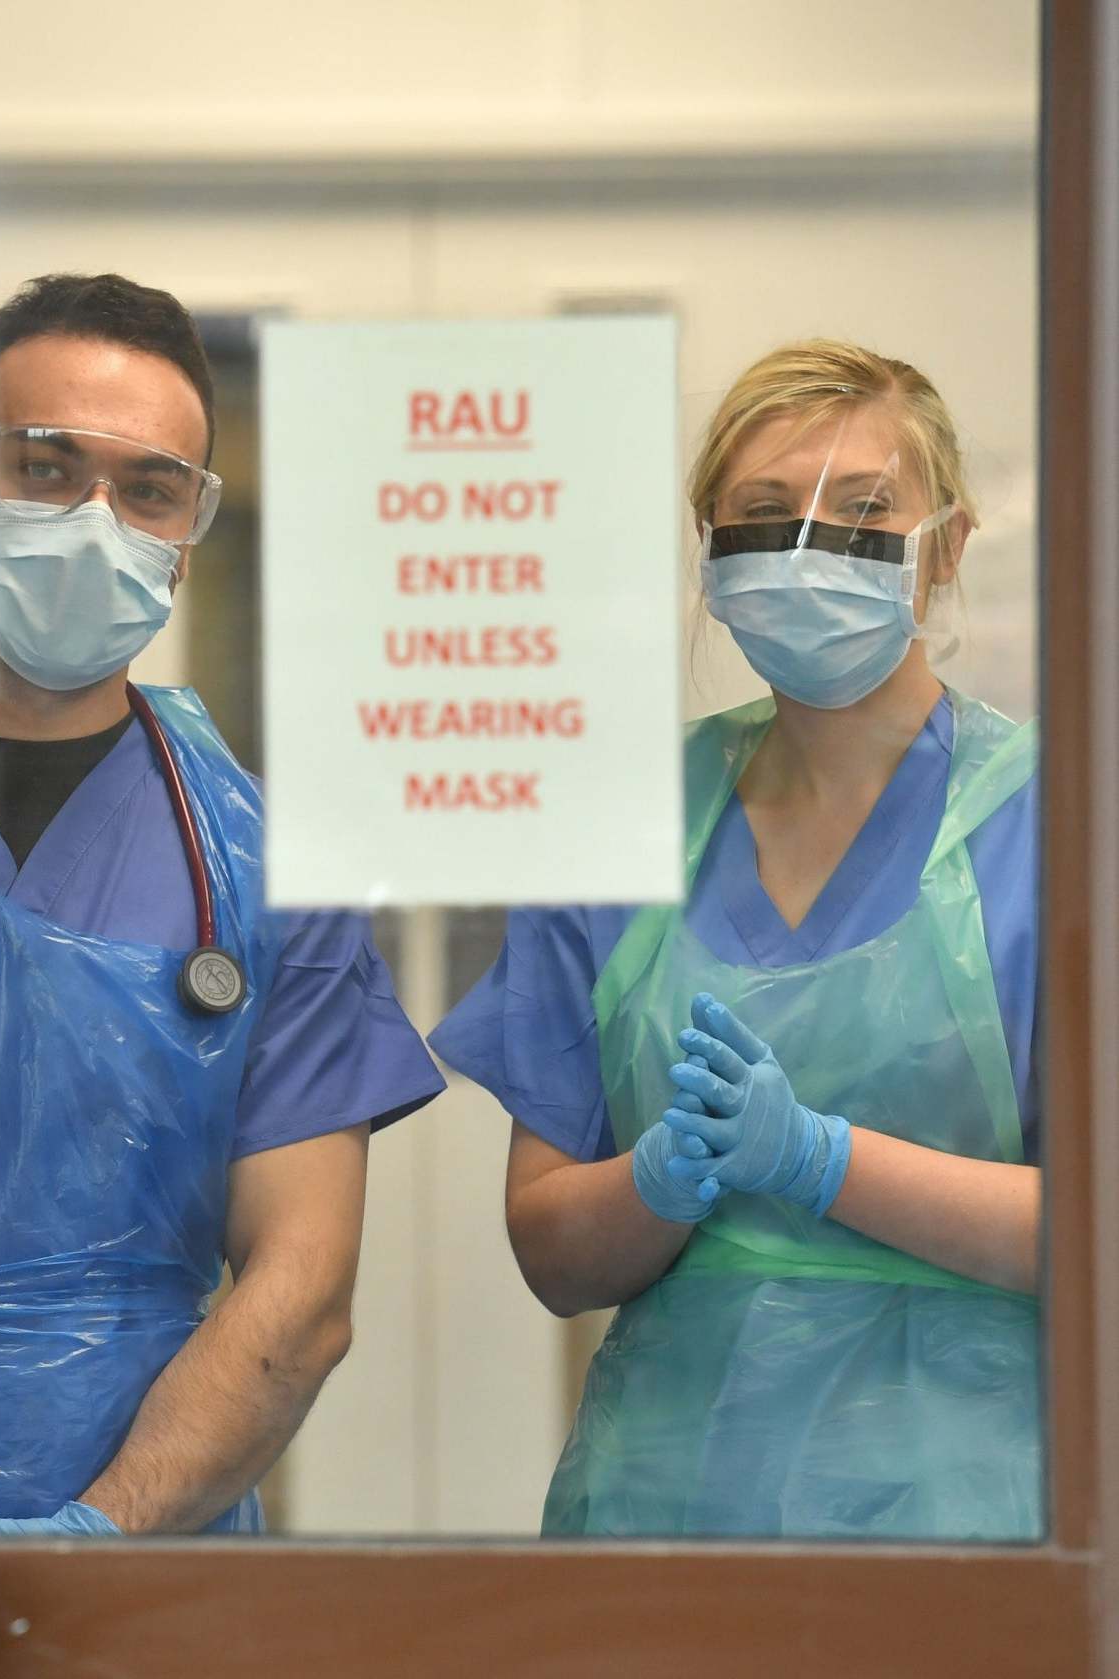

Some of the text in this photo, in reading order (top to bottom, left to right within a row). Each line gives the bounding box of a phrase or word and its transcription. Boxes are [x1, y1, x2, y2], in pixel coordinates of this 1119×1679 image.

[407, 391, 531, 441] RAU
[378, 481, 561, 522] DO NOT
[398, 555, 544, 594] ENTER
[385, 627, 558, 667] UNLESS
[358, 700, 585, 740] WEARING
[404, 774, 541, 811] MASK
